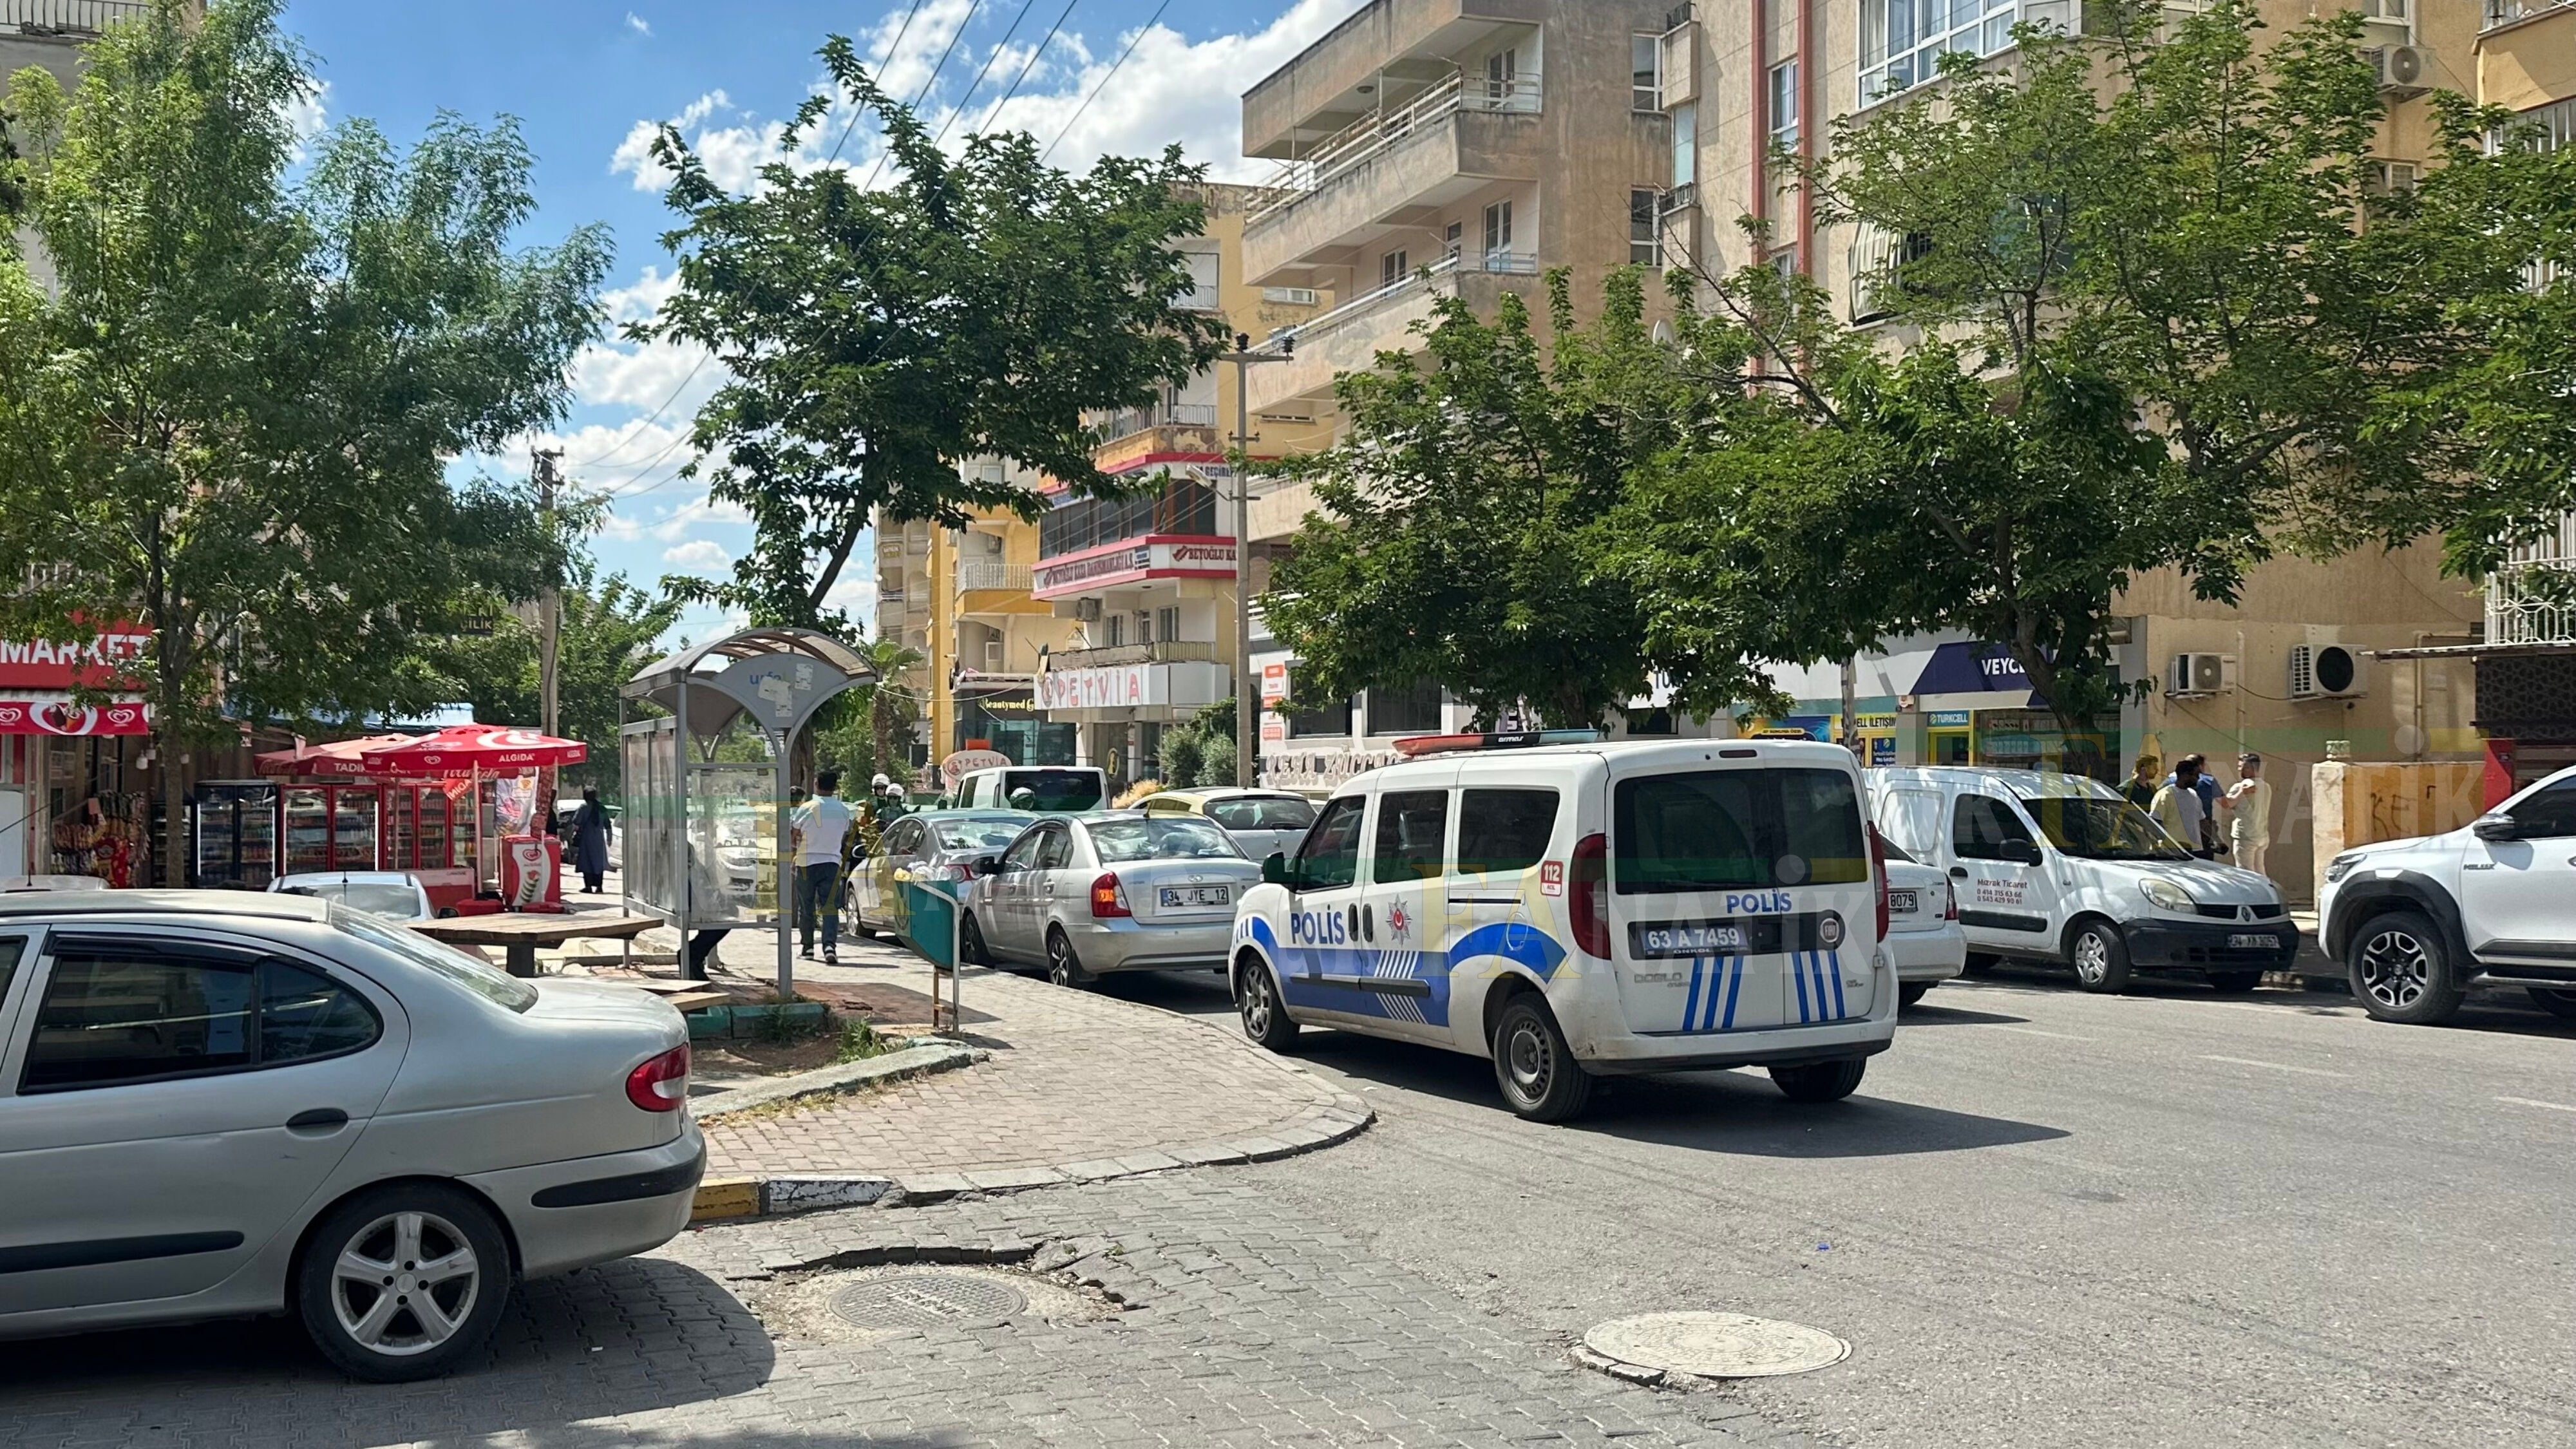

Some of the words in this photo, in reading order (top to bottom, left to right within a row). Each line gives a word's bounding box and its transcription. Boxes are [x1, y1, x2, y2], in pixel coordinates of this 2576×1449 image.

[0, 634, 147, 666] MARKET
[1936, 713, 1968, 723] TURKCELL
[498, 752, 533, 763] ALGIDA
[1544, 864, 1560, 882] 112
[1168, 890, 1180, 902] 34
[1188, 889, 1205, 901] JYE
[1215, 889, 1226, 900] 12
[1726, 889, 1792, 914] POLİS
[1889, 894, 1915, 907] 8079
[1291, 904, 1345, 945] POLİS
[1647, 930, 1672, 949] 63
[1677, 930, 1692, 947] A
[1694, 928, 1740, 948] 7459
